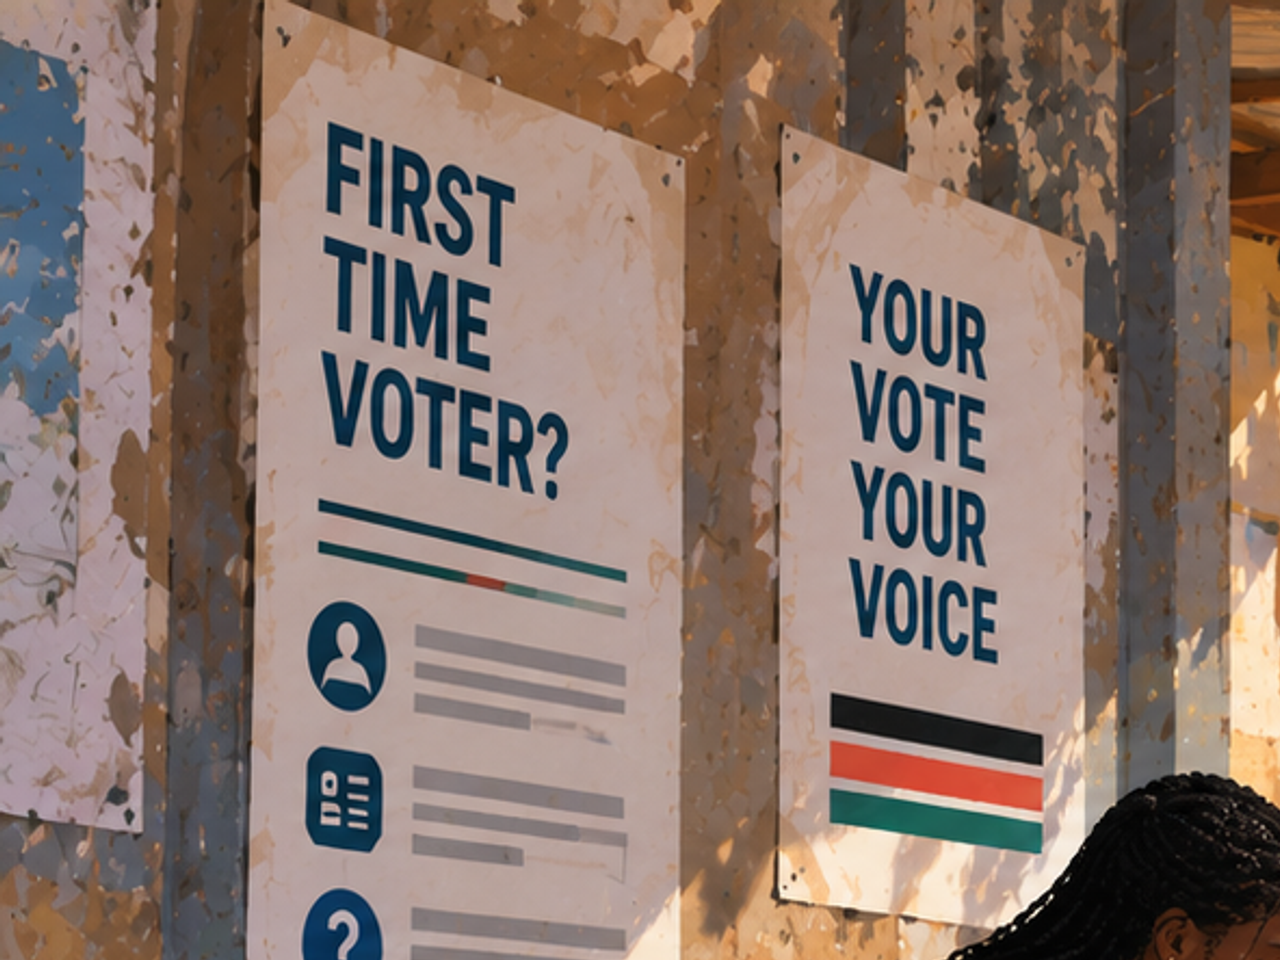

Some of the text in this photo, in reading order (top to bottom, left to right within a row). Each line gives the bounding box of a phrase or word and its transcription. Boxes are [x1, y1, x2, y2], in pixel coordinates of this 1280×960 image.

[326, 121, 516, 268] FIRST
[323, 235, 491, 372] TIME
[849, 264, 987, 381] YOUR
[321, 350, 570, 501] VOTER?
[850, 360, 987, 474] VOTE
[850, 460, 987, 567] YOUR
[848, 557, 998, 664] VOICE
